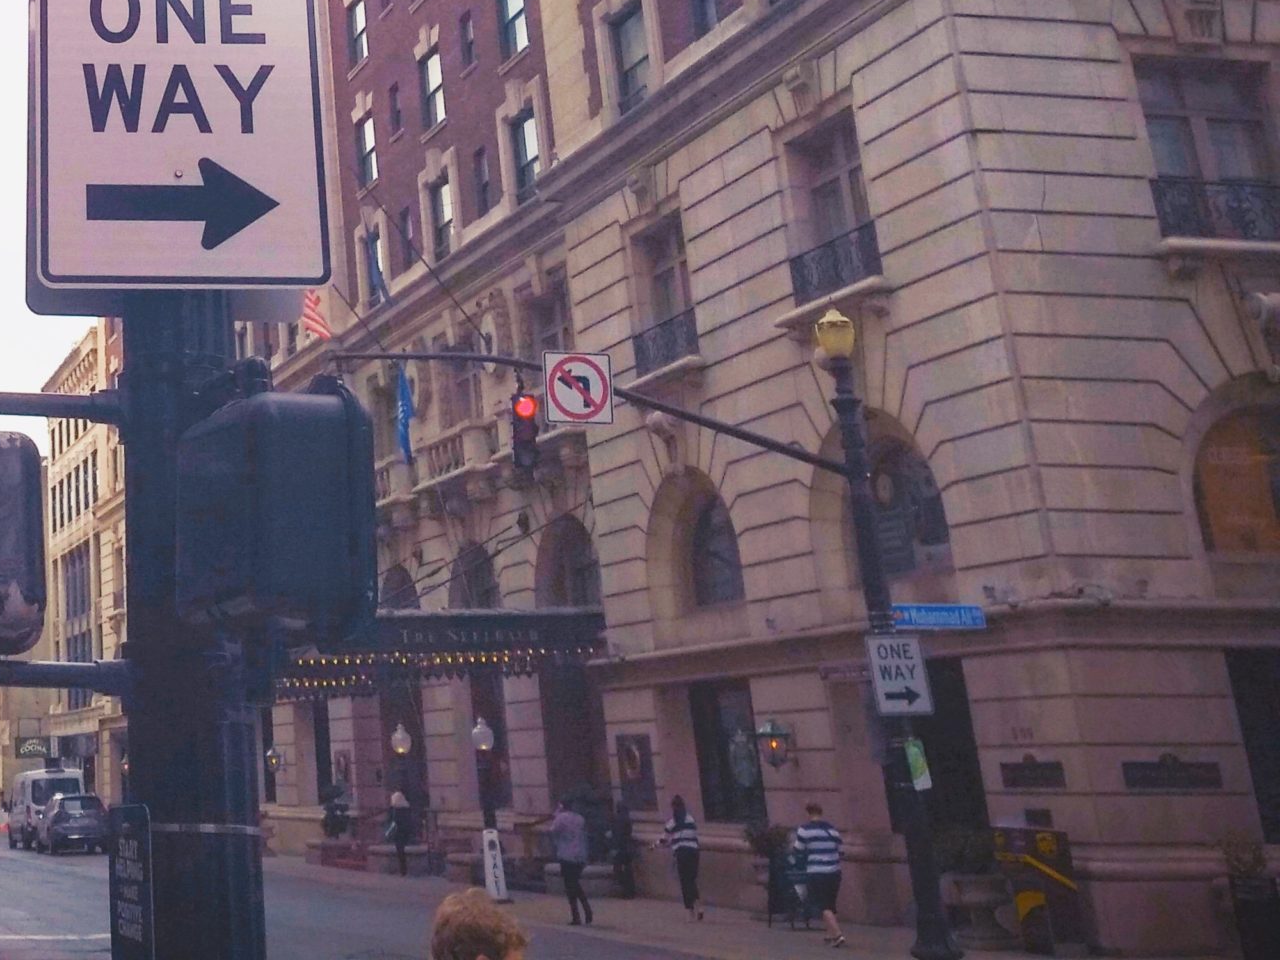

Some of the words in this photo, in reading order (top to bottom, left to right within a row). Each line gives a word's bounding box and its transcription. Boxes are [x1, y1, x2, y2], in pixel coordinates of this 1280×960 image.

[82, 63, 275, 134] WAY
[877, 643, 913, 660] ONE
[879, 664, 916, 681] WAY
